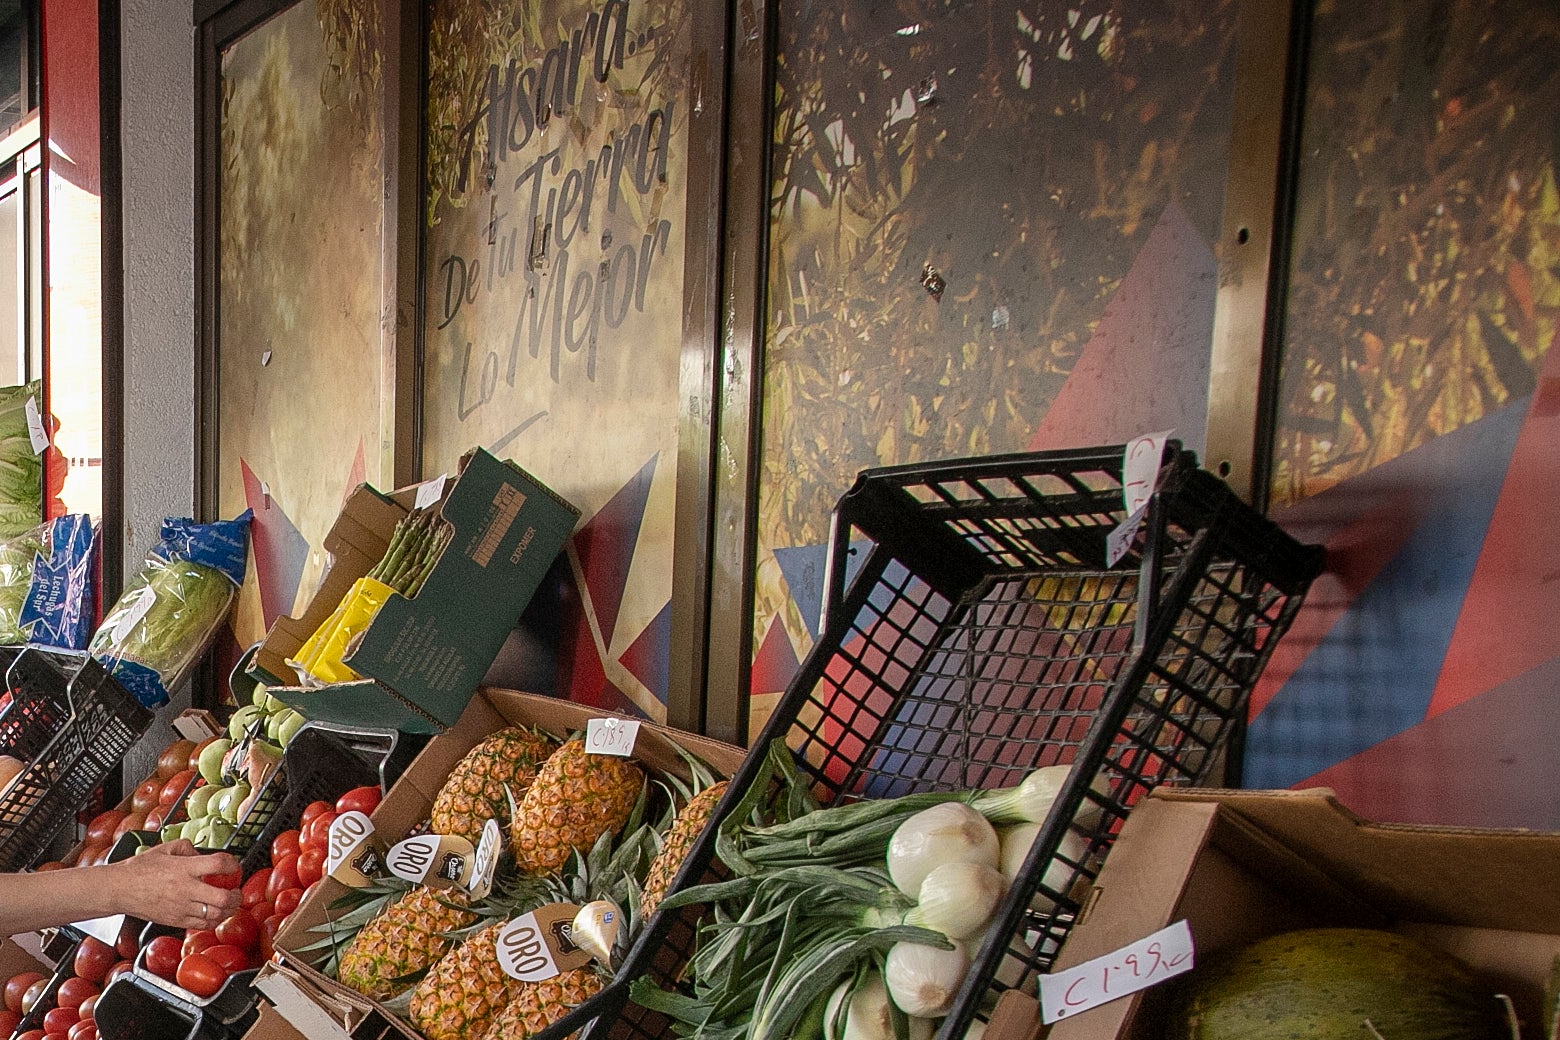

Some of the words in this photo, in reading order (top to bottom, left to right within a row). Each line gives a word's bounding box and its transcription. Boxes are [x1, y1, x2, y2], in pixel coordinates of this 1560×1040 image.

[438, 254, 480, 330] De
[514, 100, 675, 278] Tierra
[458, 342, 499, 422] Lo
[506, 219, 672, 388] Mejor
[33, 595, 47, 612] Sur
[39, 578, 50, 593] del
[45, 576, 64, 617] Lechugas
[331, 815, 365, 860] ORO
[392, 841, 433, 876] ORO
[476, 824, 495, 876] ORO
[503, 926, 548, 975] ORO
